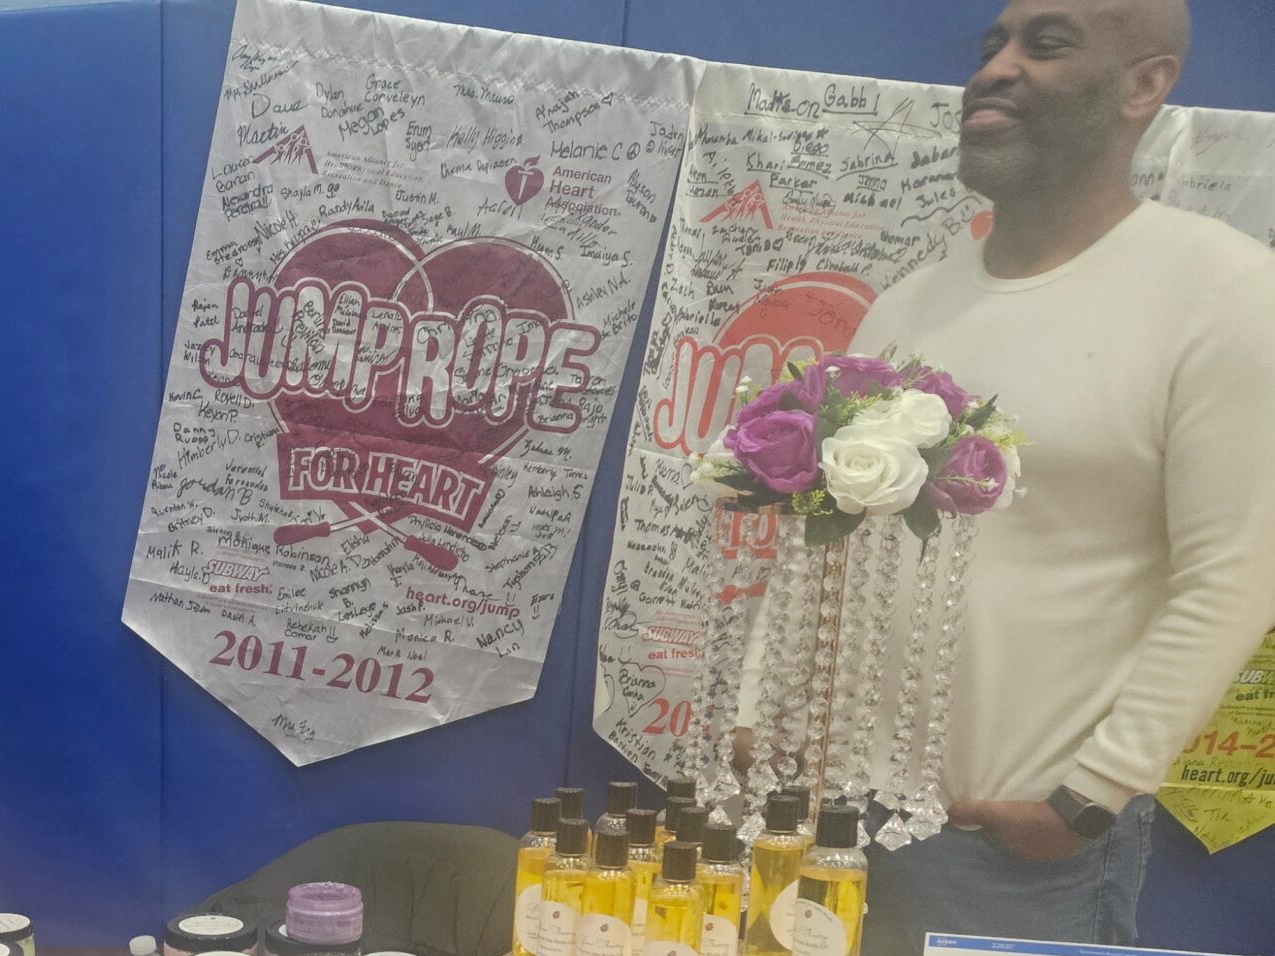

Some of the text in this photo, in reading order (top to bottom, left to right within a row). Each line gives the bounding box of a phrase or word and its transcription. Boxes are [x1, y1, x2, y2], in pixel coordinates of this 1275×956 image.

[553, 165, 612, 184] American
[549, 180, 595, 199] Heart
[199, 277, 406, 412] JUMP
[397, 296, 601, 433] ROPE
[288, 446, 362, 493] FOR
[361, 450, 486, 521] HEART
[202, 559, 270, 582] SUBWAY
[209, 583, 231, 594] eat
[406, 586, 521, 620] heart.org/jump
[209, 629, 434, 704] 2011-2012
